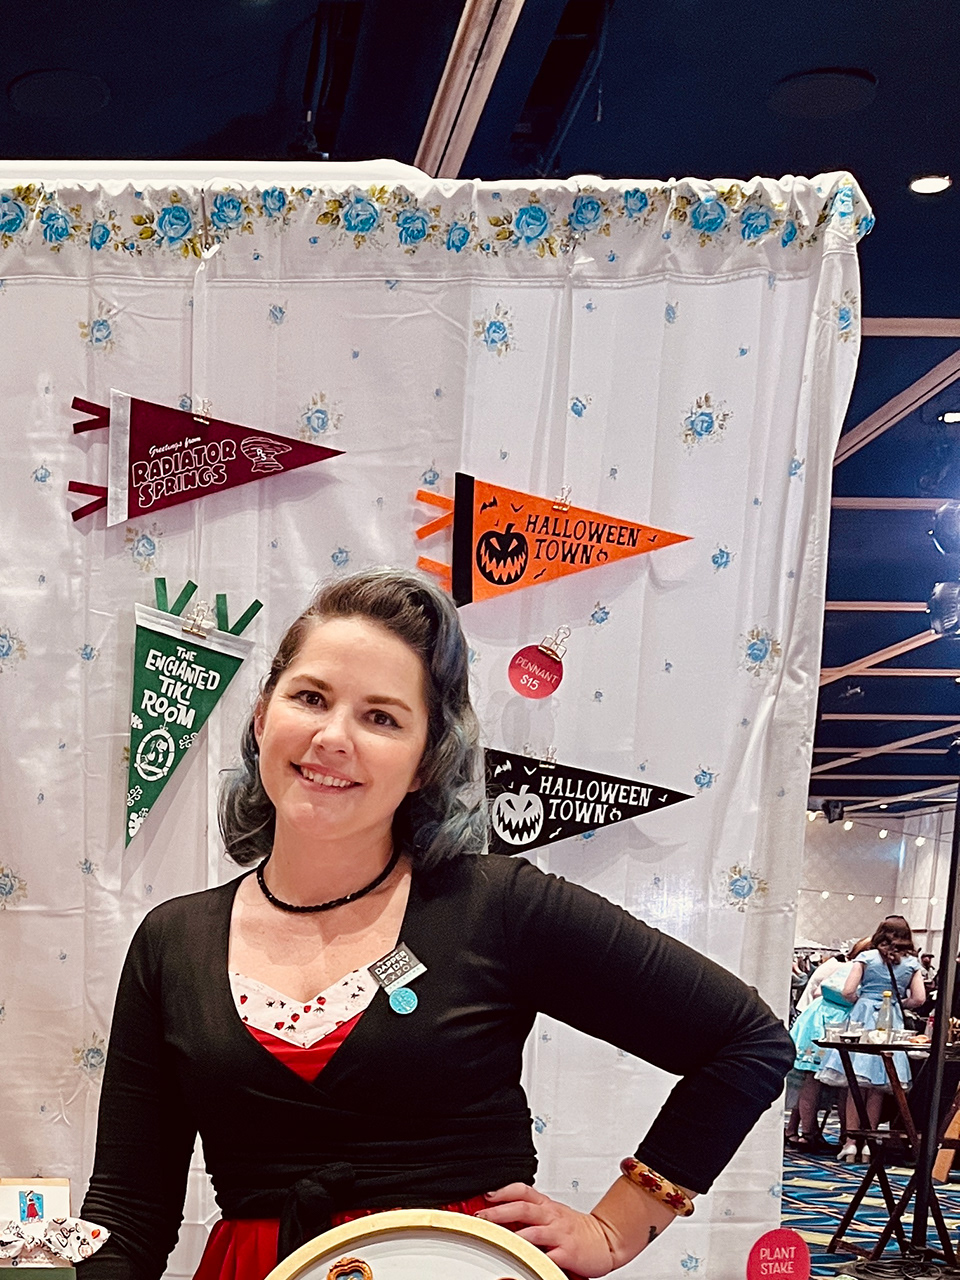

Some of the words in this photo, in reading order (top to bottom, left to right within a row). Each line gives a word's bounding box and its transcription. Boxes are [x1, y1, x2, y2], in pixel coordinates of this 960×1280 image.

[149, 441, 183, 457] Greetings
[185, 436, 202, 449] from
[132, 439, 237, 487] RADIATOR
[138, 463, 228, 508] SPRINGS
[525, 514, 642, 548] HALLOWEEN
[534, 538, 595, 565] TOWN
[176, 646, 198, 661] THE
[144, 648, 221, 690] ENCHANTED
[515, 656, 559, 684] PENNANT
[520, 674, 540, 690] $15
[159, 674, 194, 706] TIKI
[141, 689, 196, 729] ROOM
[539, 776, 654, 807] HALLOWEEN
[548, 798, 609, 824] TOWN
[374, 950, 407, 975] DAPPER
[384, 964, 410, 985] EXPO
[392, 955, 410, 971] DAY
[760, 1246, 797, 1260] PLANT
[760, 1261, 795, 1276] STAKE
